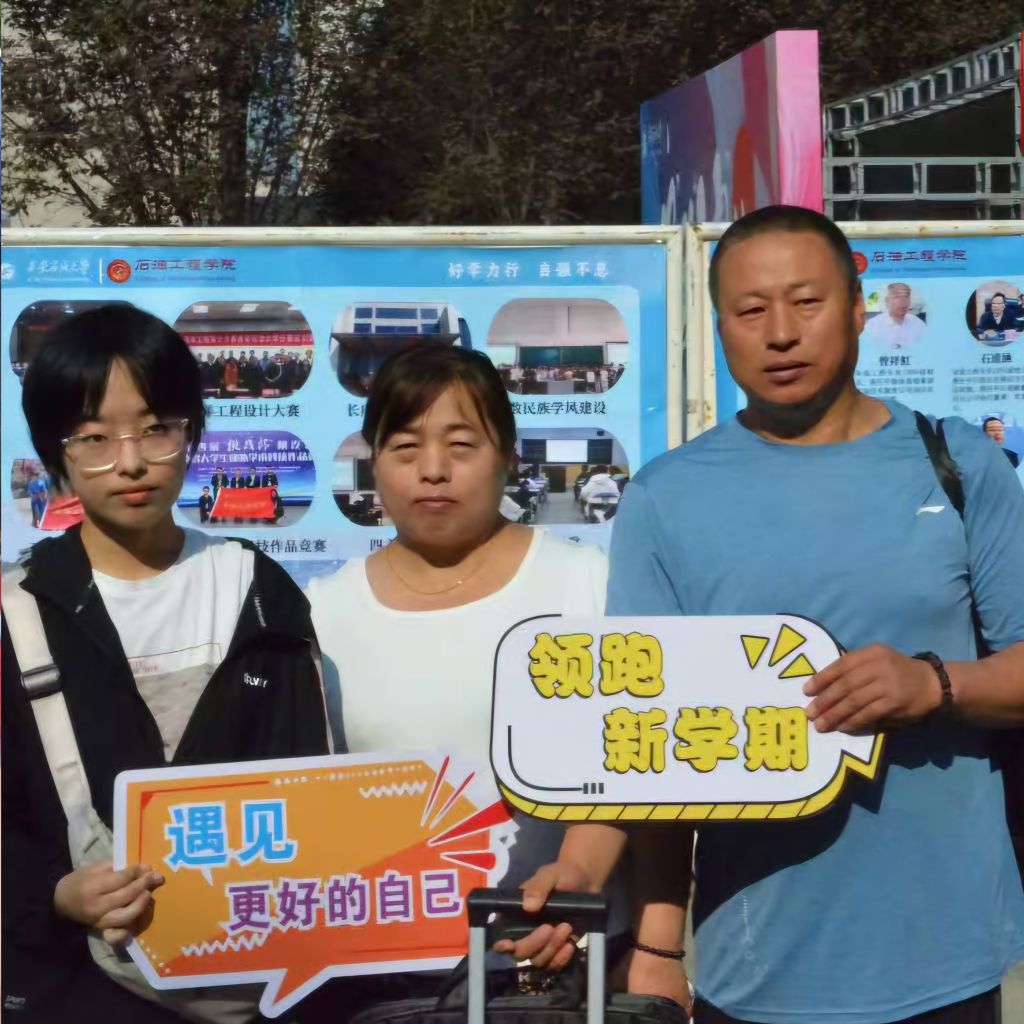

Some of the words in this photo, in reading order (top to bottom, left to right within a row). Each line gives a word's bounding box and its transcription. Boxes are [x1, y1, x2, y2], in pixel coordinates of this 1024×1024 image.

[135, 258, 237, 272] 石油工程学院
[871, 250, 968, 263] 石油工程学院
[528, 632, 665, 699] 领跑
[602, 706, 810, 773] 新学期
[163, 799, 298, 870] 遇见
[222, 870, 464, 934] 更好的自己
